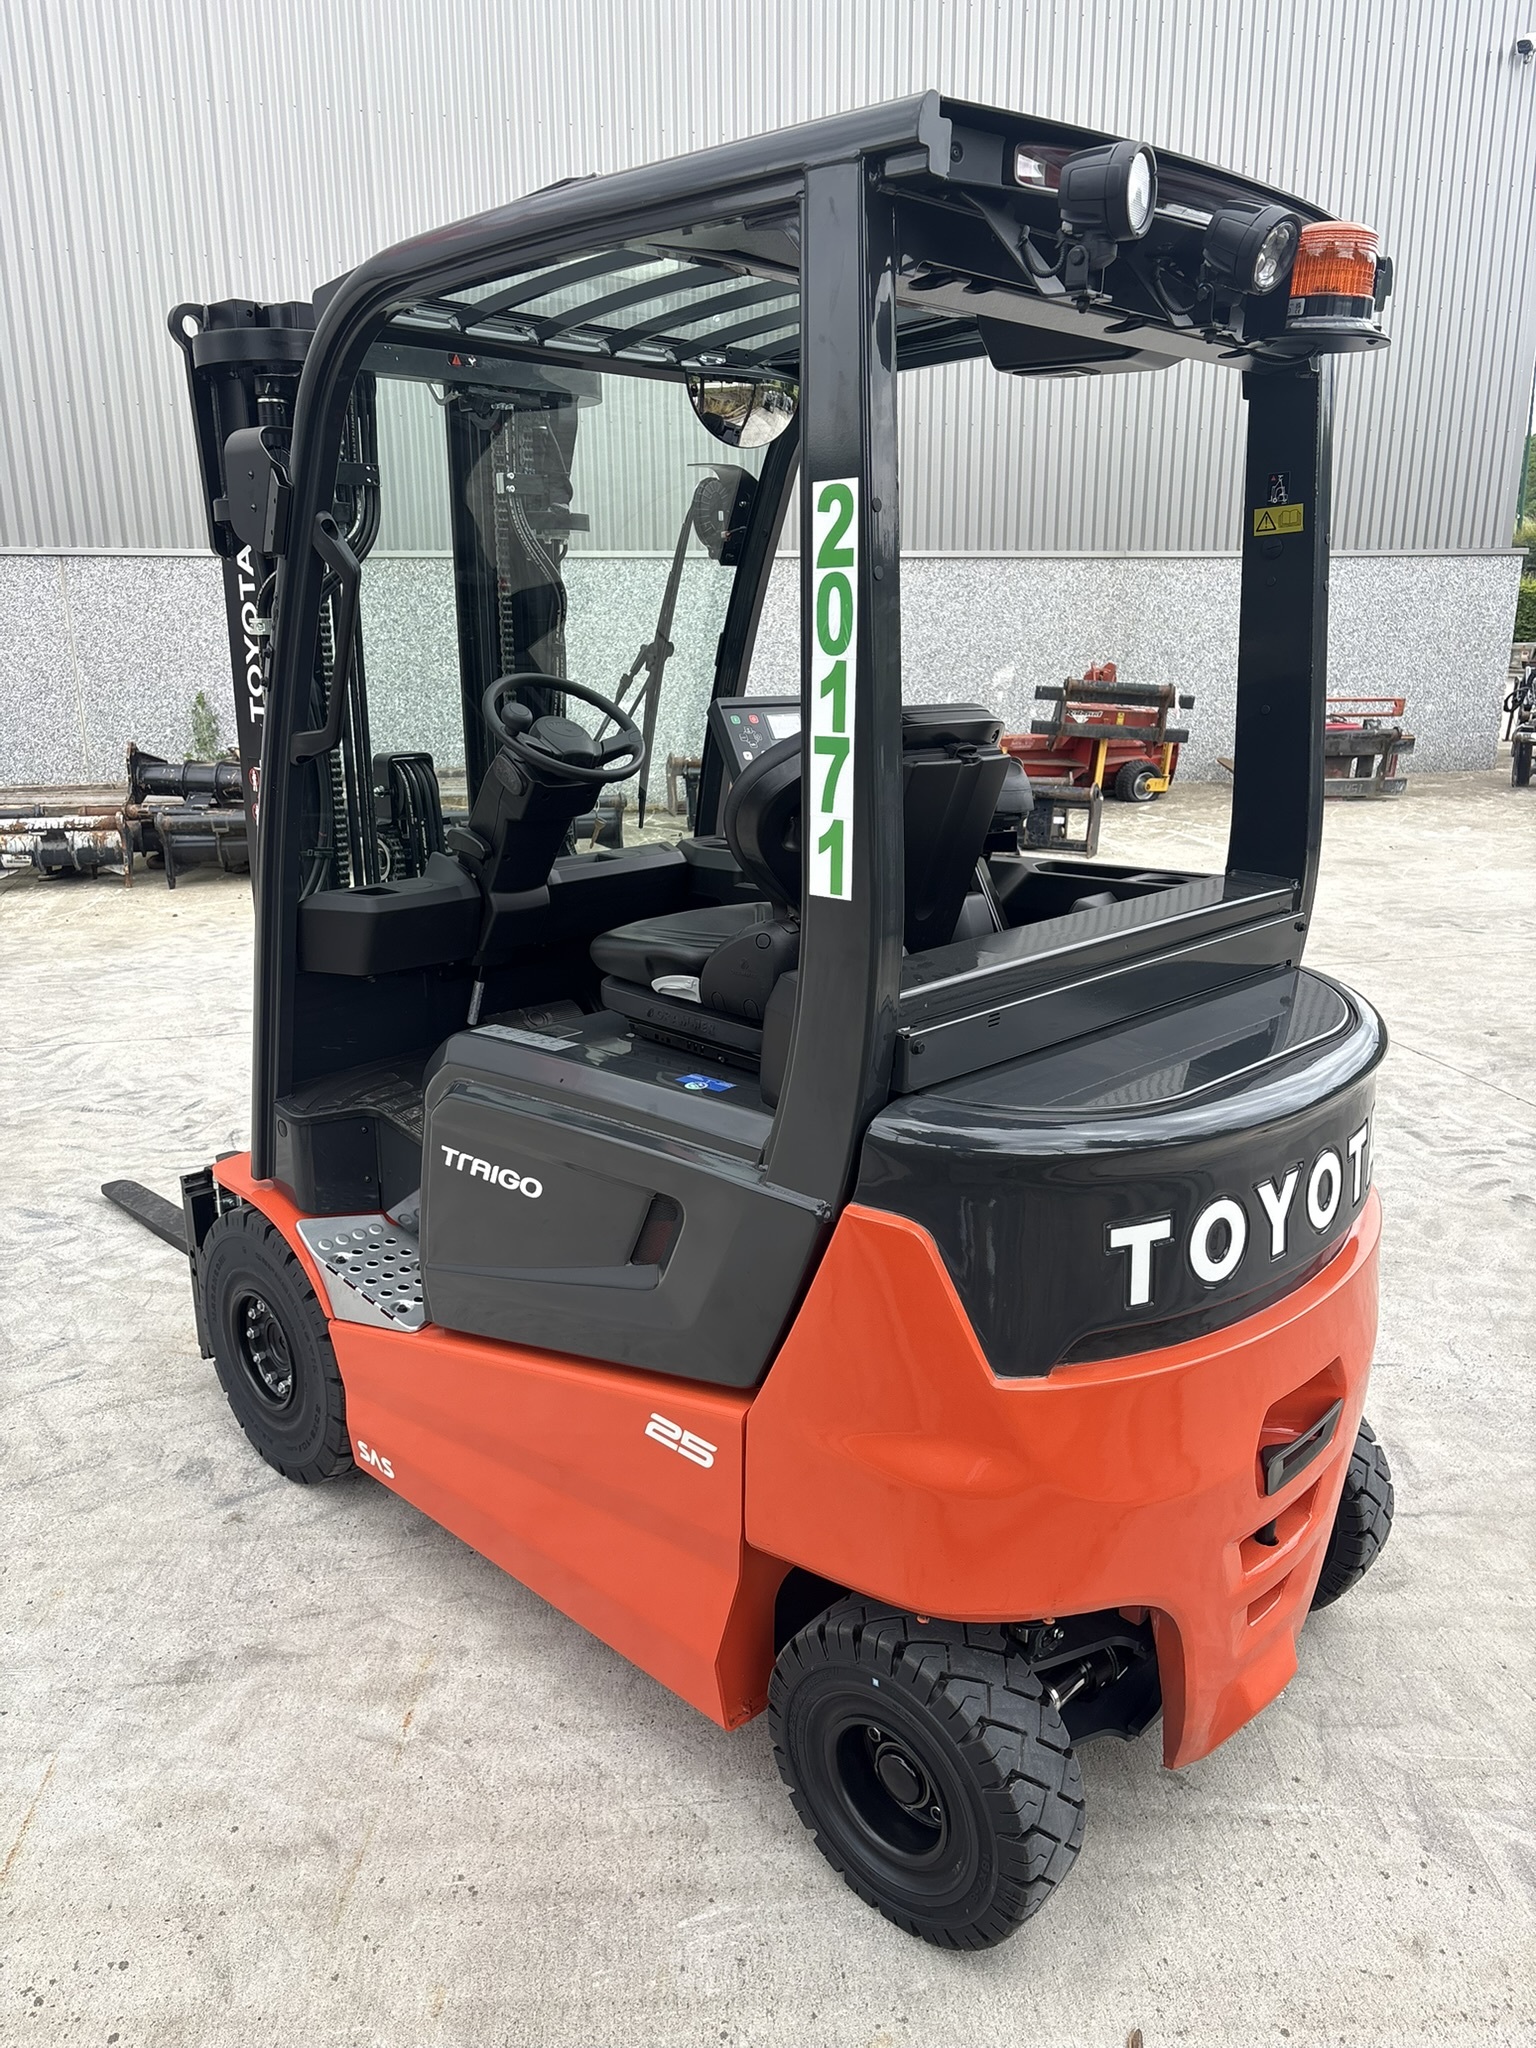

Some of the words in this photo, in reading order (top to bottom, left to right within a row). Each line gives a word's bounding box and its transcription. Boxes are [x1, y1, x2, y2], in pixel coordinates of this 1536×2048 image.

[237, 545, 265, 723] TOYOTA
[815, 485, 853, 894] 20171
[1110, 1114, 1374, 1306] TOYOT
[358, 1441, 394, 1478] SAS
[645, 1414, 717, 1468] 25
